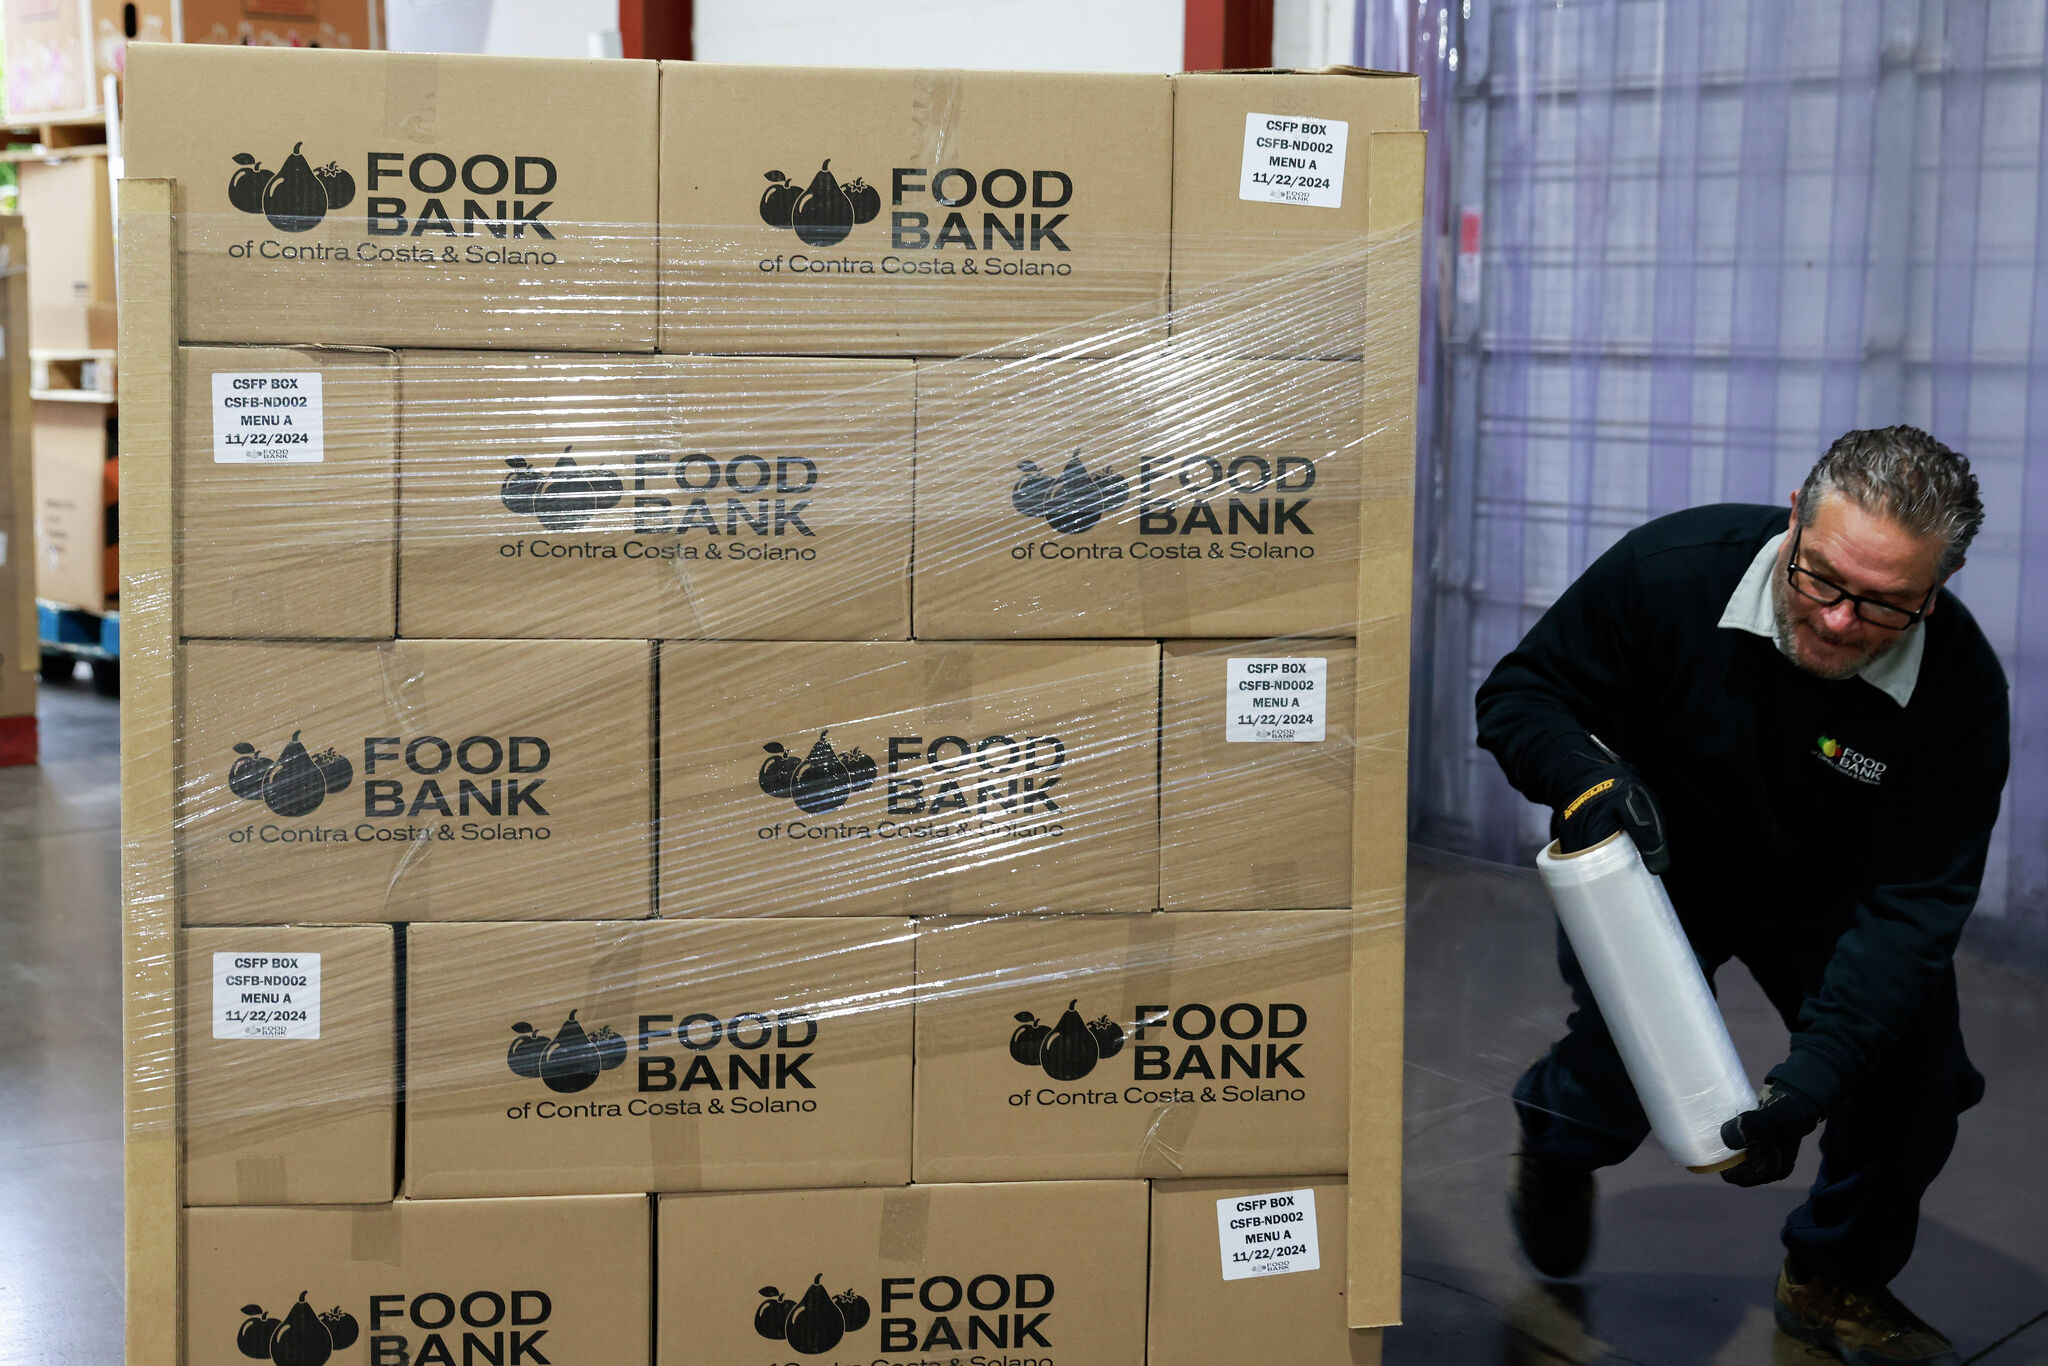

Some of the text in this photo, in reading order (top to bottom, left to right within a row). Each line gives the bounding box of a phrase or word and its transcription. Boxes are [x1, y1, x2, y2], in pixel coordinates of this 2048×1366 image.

[1266, 120, 1327, 135] CSFP BOX
[1256, 137, 1333, 153] CSFB-ND002
[367, 152, 557, 195] FOOD
[1269, 156, 1317, 170] MENU A
[892, 167, 1073, 208] FOOD
[1252, 172, 1330, 188] 11/22/2024
[367, 197, 556, 240] BANK
[891, 211, 1071, 251] BANK
[228, 241, 557, 265] of Contra Costa & Solano
[759, 255, 1071, 276] of Contra Costa & Solano
[233, 379, 298, 389] CSFP BOX
[224, 397, 307, 407] CSFB-ND002
[241, 415, 292, 425] MENU A
[225, 433, 308, 446] 11/22/2024
[634, 453, 818, 494] FOOD
[1140, 455, 1316, 494] FOOD
[634, 498, 816, 537] BANK
[1139, 498, 1314, 535] BANK
[500, 540, 817, 561] of Contra Costa & Solano
[1012, 541, 1314, 559] of Contra Costa & Solano
[1247, 664, 1306, 673] CSFP BOX
[1239, 681, 1314, 690] CSFB-ND002
[1253, 698, 1300, 707] MENU A
[1238, 715, 1313, 726] 11/22/2024
[364, 735, 550, 775] FOOD
[888, 735, 1065, 773] FOOD
[1843, 747, 1887, 772] FOOD
[1839, 757, 1881, 780] BANK
[365, 779, 550, 817] BANK
[888, 778, 1062, 815] BANK
[229, 823, 551, 843] of Contra Costa & Solano
[758, 822, 782, 840] of
[787, 822, 871, 839] Contra
[878, 821, 949, 839] Costa
[235, 958, 298, 968] CSFP BOX
[226, 976, 306, 986] CSFB-ND002
[241, 994, 291, 1003] MENU A
[226, 1011, 307, 1023] 11/22/2024
[1135, 1003, 1307, 1040] FOOD
[638, 1012, 818, 1051] FOOD
[638, 1053, 817, 1092] BANK
[1134, 1044, 1305, 1080] BANK
[1008, 1085, 1305, 1106] of Contra Costa & Solano
[507, 1097, 817, 1119] of Contra Costa & Solano
[1237, 1196, 1294, 1212] CSFP BOX
[1230, 1212, 1303, 1229] CSFB-ND002
[1246, 1230, 1291, 1244] MENU A
[1233, 1244, 1306, 1262] 11/22/2024
[881, 1274, 1054, 1313] FOOD
[370, 1290, 551, 1331] FOOD
[880, 1313, 1052, 1353] BANK
[370, 1330, 551, 1366] BANK
